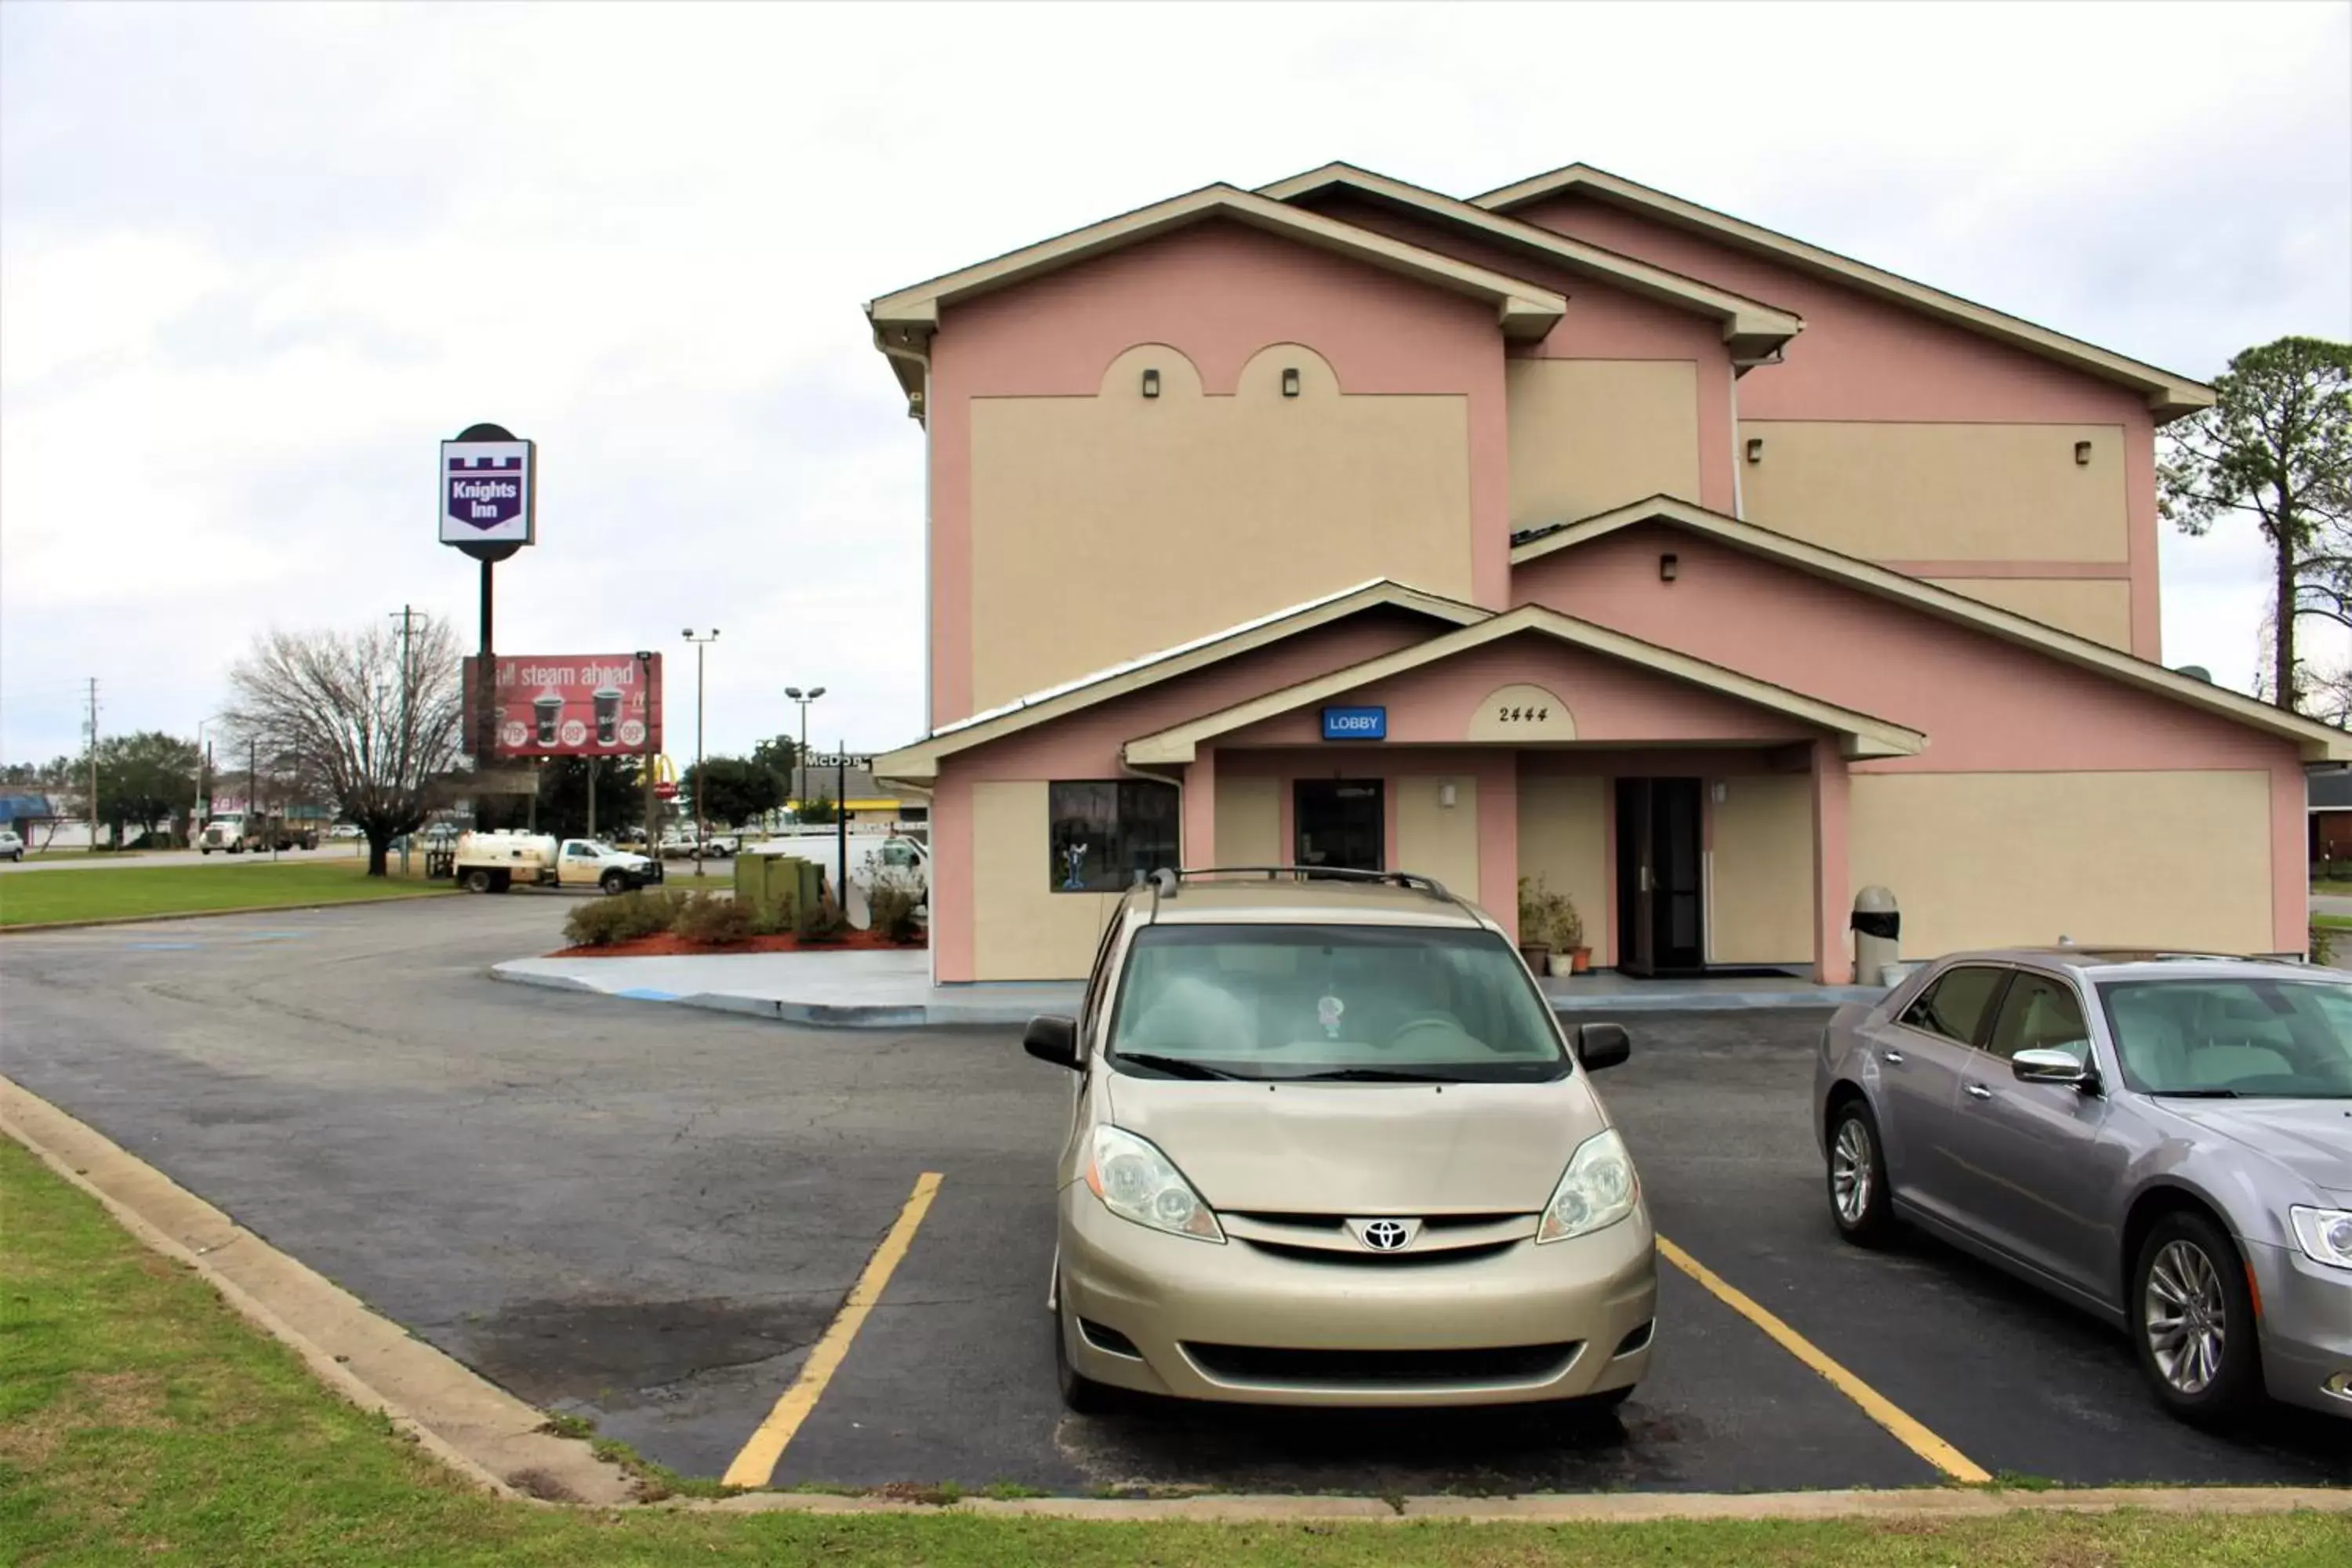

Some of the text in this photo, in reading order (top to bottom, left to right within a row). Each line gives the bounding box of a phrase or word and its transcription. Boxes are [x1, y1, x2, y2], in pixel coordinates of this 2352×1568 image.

[453, 481, 517, 502] Knights
[471, 501, 497, 518] Inn
[521, 666, 575, 687] steam
[582, 662, 633, 685] ahead
[1330, 717, 1378, 730] LOBBY
[1499, 708, 1549, 722] 2444
